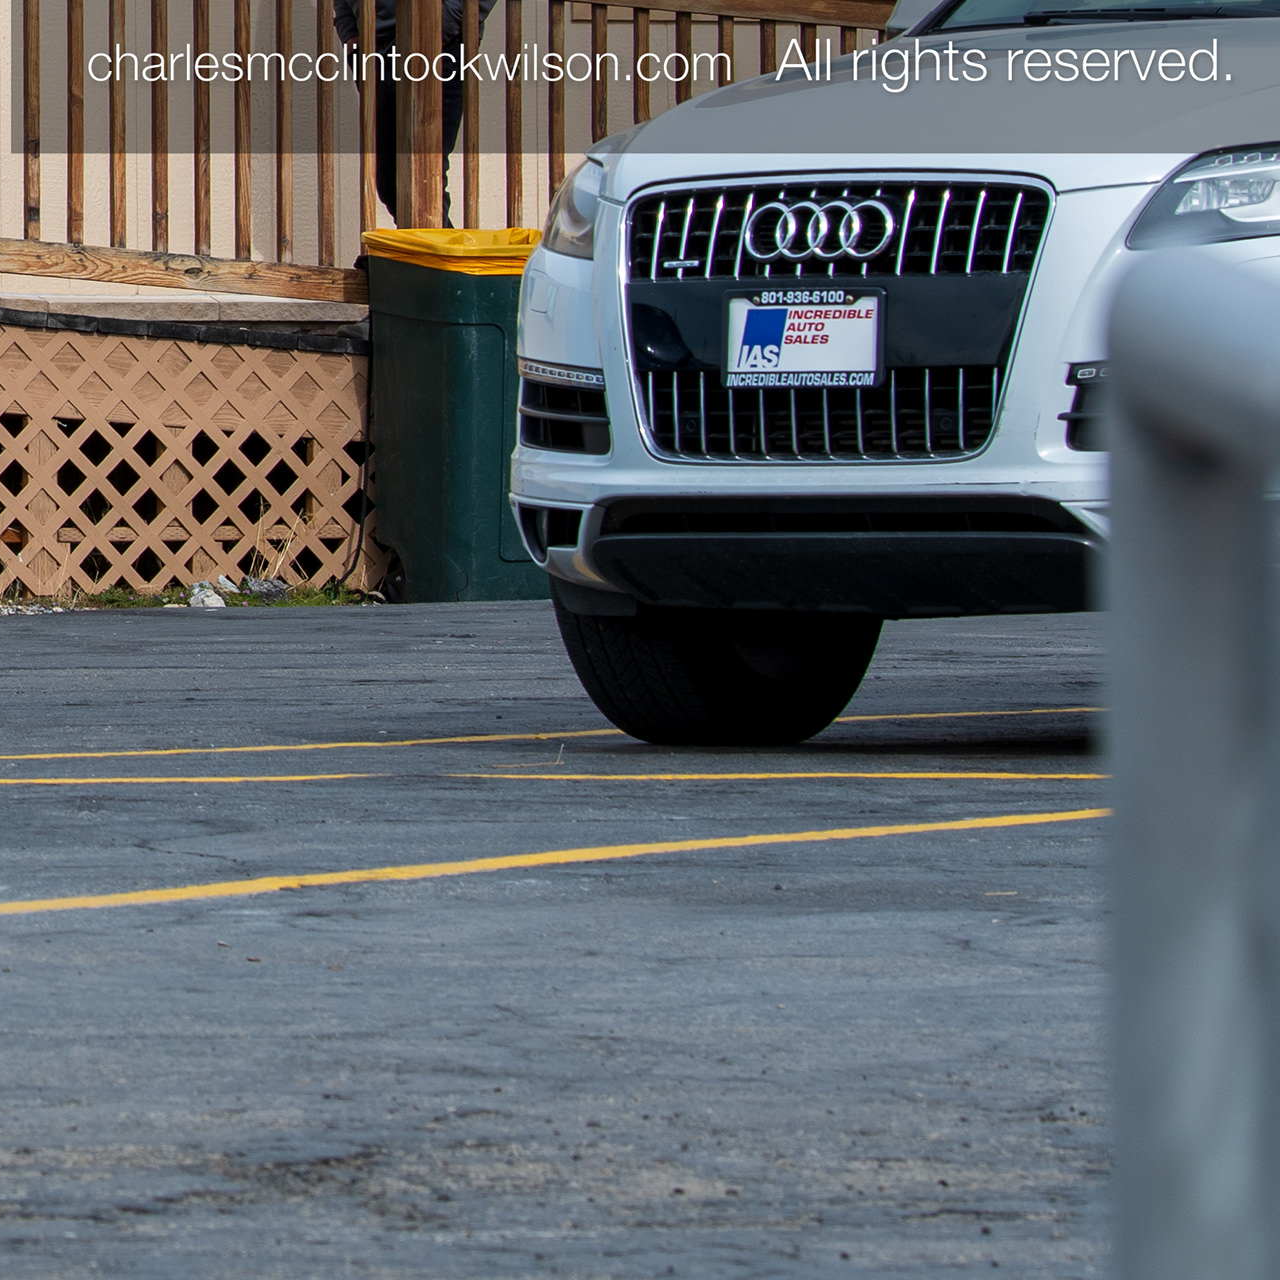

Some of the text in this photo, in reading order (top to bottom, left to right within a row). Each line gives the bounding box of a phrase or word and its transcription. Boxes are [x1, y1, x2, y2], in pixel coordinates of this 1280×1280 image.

[761, 291, 844, 304] 801-936-6100
[788, 309, 874, 320] INCREDIBLE
[786, 322, 825, 332] AUTO
[784, 335, 829, 344] SALES
[741, 344, 779, 368] IAS
[727, 373, 874, 386] INCREDIBLEAUTOSALES.COM
